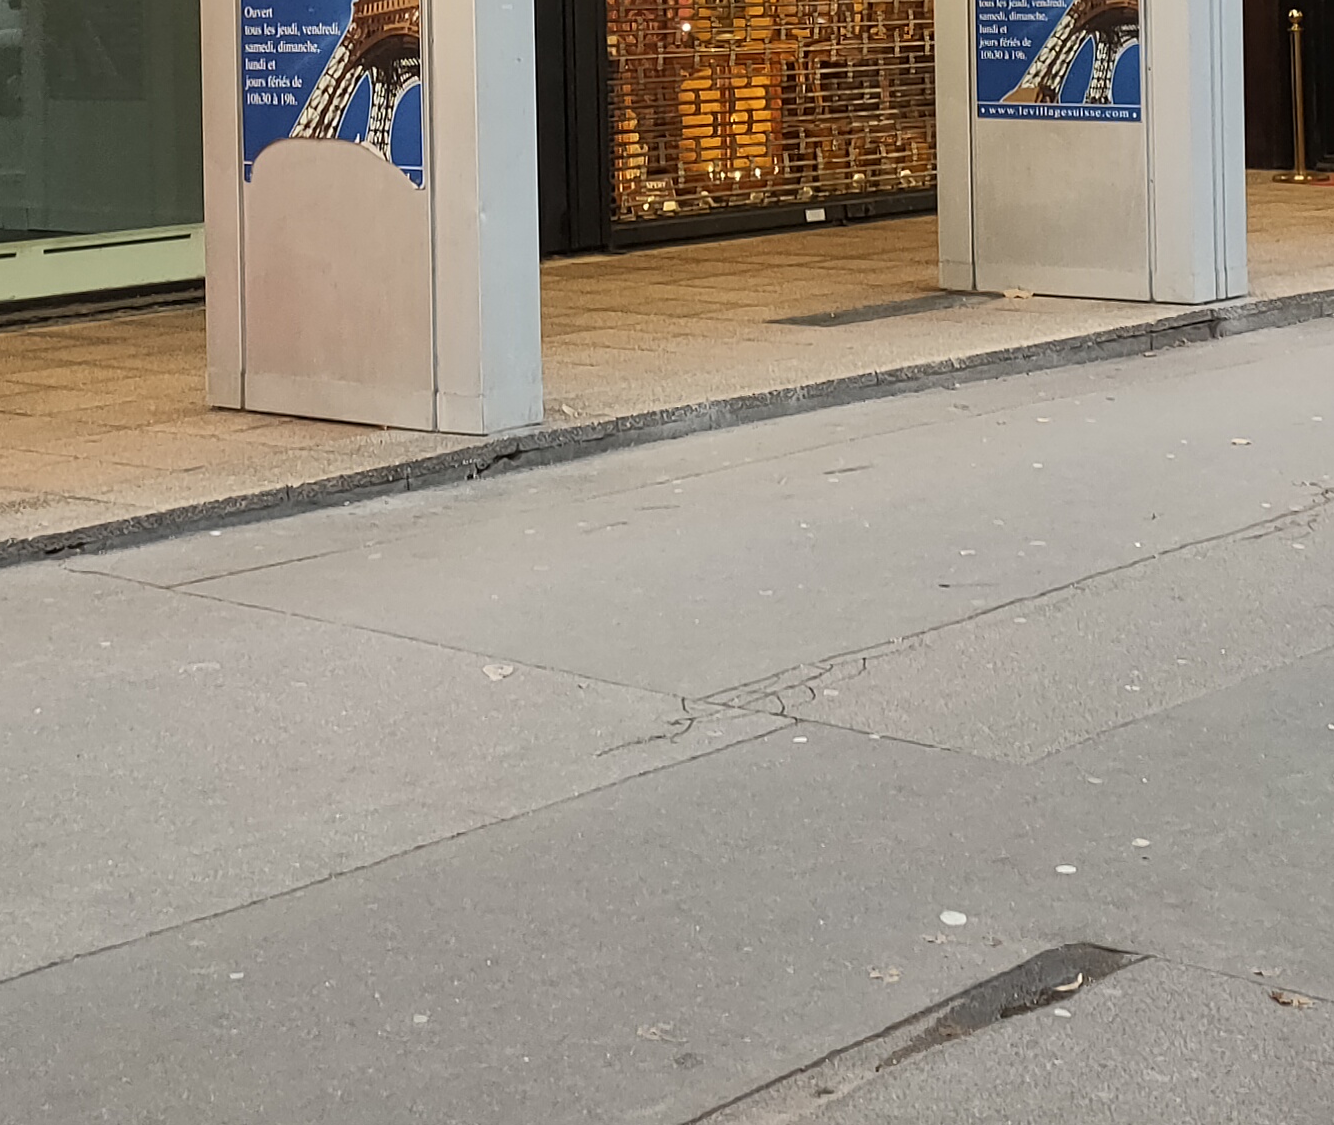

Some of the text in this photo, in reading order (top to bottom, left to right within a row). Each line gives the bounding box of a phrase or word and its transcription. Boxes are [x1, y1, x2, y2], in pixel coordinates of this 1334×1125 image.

[979, 0, 995, 8] tous
[244, 6, 273, 18] Ouvert
[244, 24, 262, 35] tous
[264, 23, 276, 35] les
[979, 24, 1008, 34] lundi et
[979, 37, 1032, 49] jours fériés de
[980, 50, 1003, 60] 10h30
[1004, 50, 1010, 60] à
[245, 58, 276, 71] lundi et
[245, 75, 303, 90] jours fériés de
[247, 93, 272, 105] 10h30
[272, 93, 278, 105] à
[989, 106, 1130, 119] www.levillagesuisse.com
